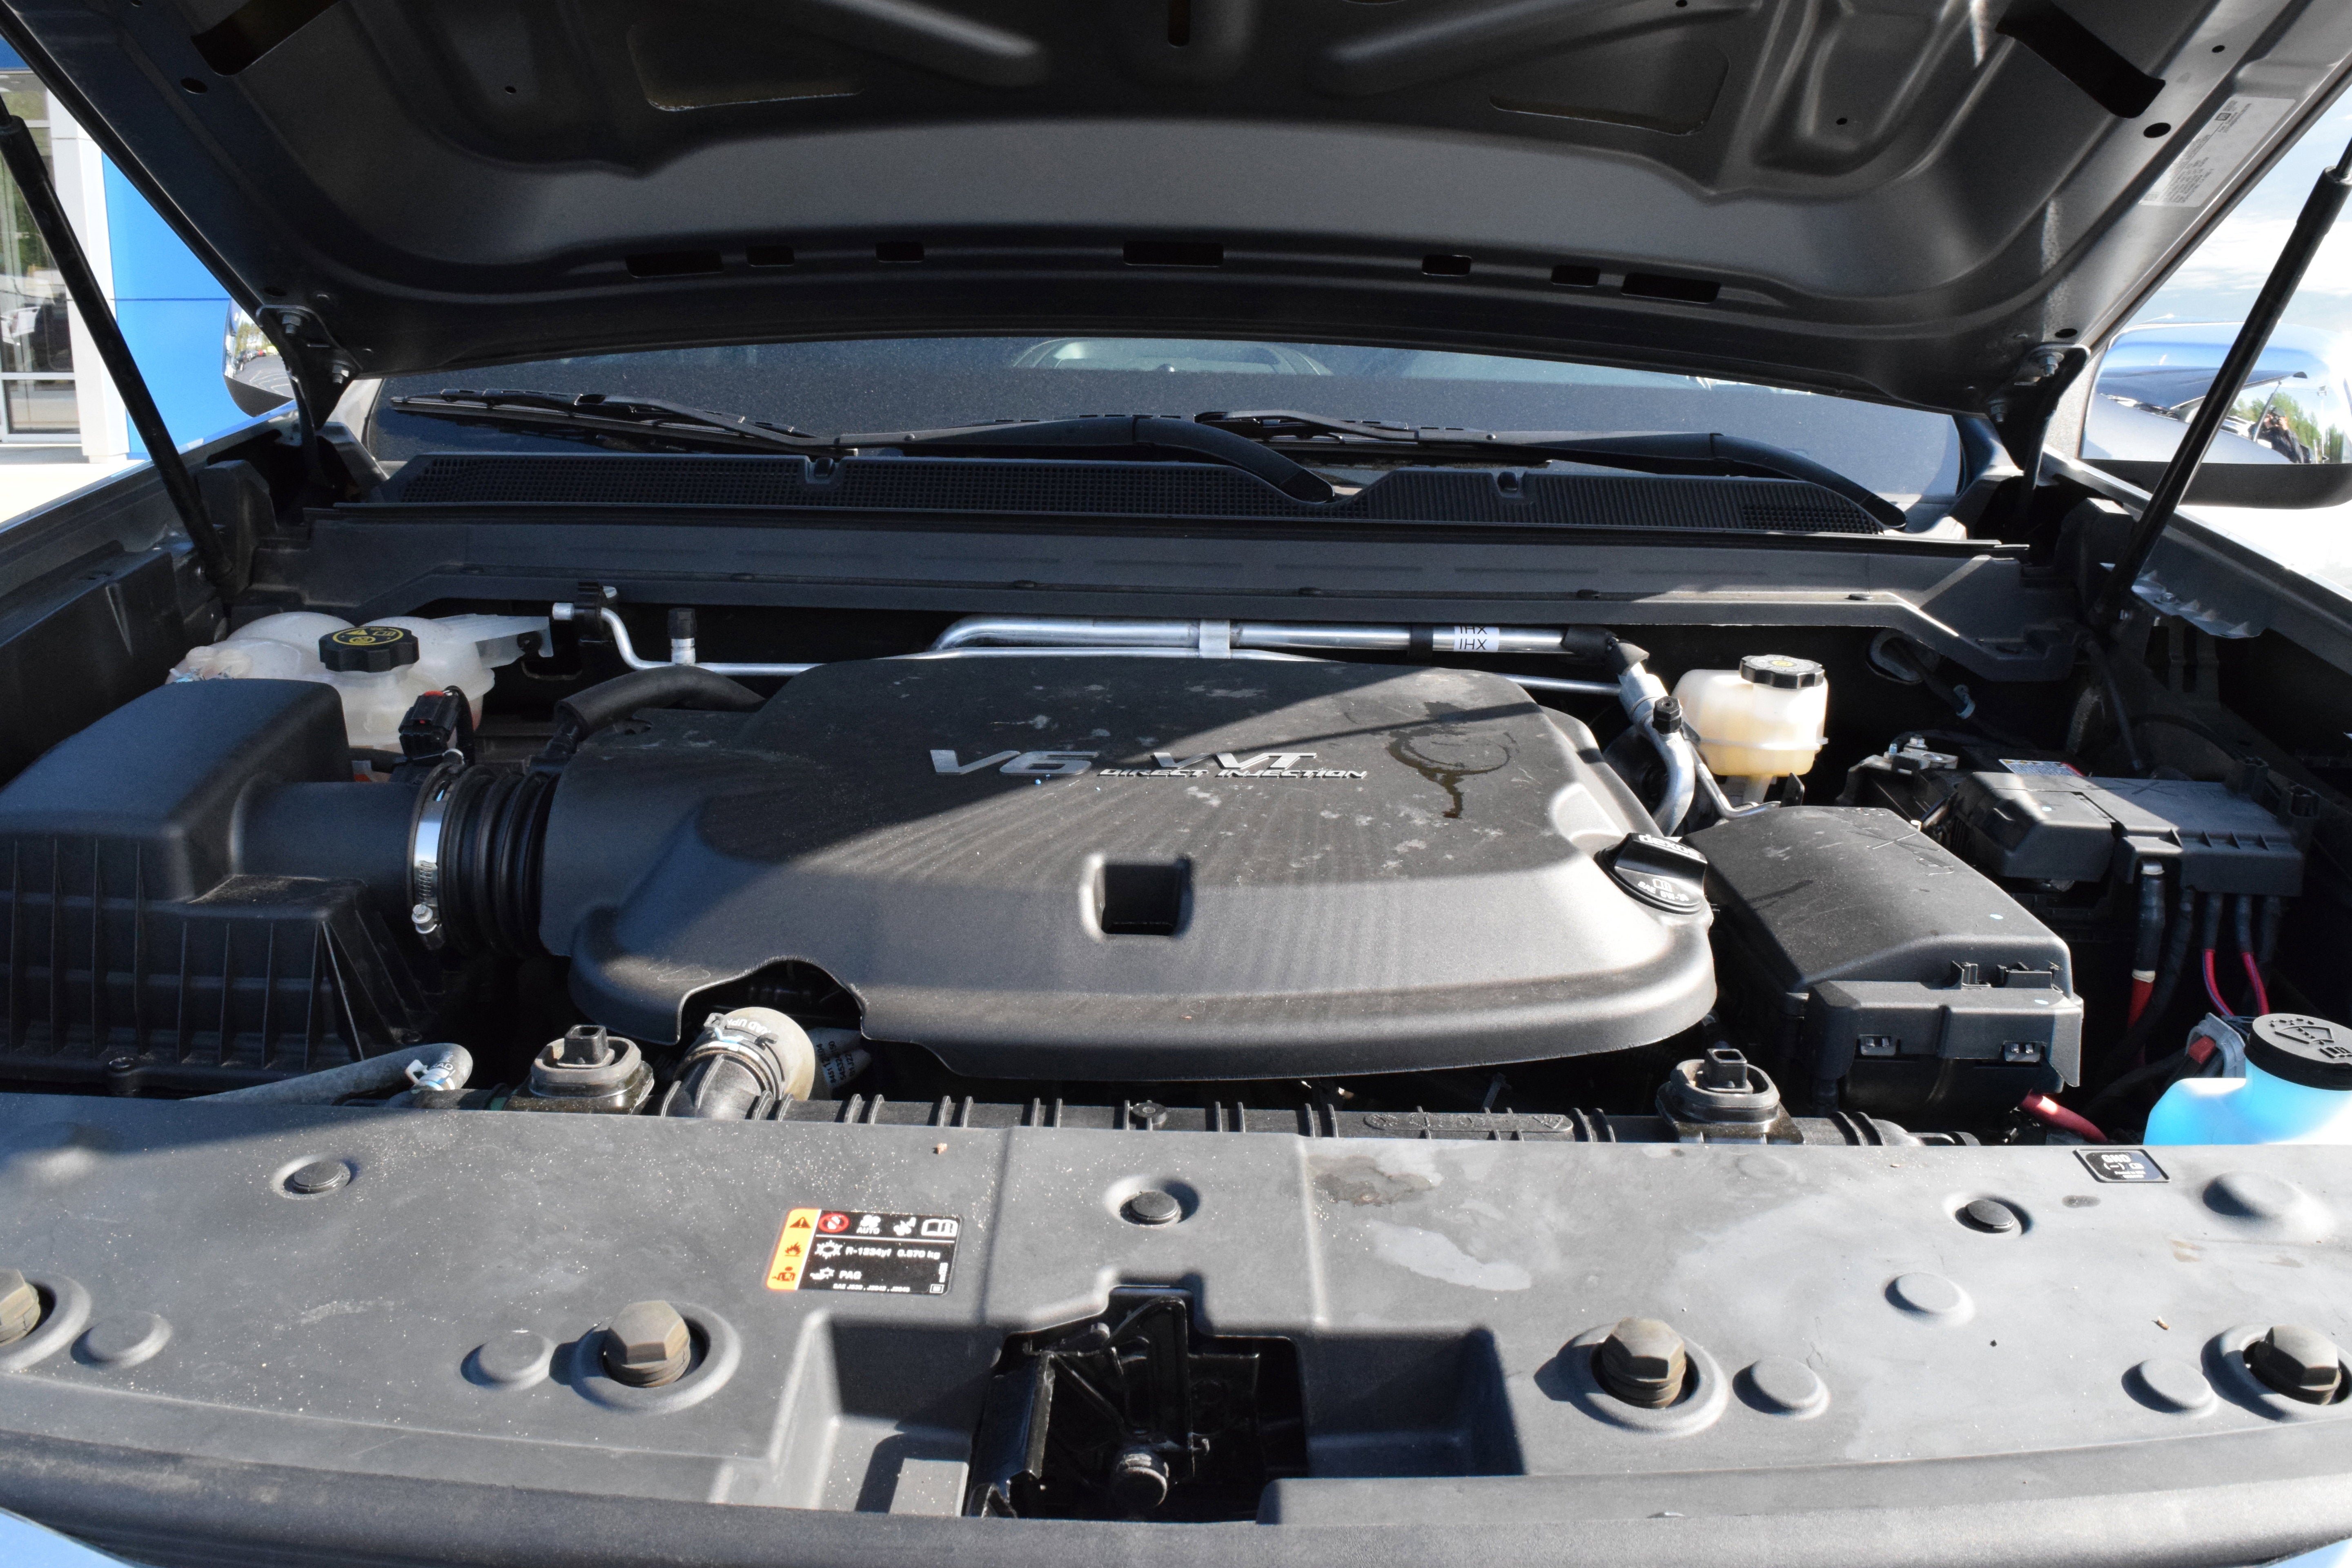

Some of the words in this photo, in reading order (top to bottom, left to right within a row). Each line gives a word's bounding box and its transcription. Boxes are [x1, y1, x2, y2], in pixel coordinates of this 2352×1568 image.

[1459, 638, 1487, 650] IHX
[930, 749, 1099, 775] V6
[1152, 752, 1317, 769] VVT
[1100, 768, 1209, 777] DIRECT
[1216, 769, 1368, 779] INJECTION
[1638, 834, 1701, 859] dexos
[1637, 881, 1657, 894] SAE
[2101, 1154, 2131, 1163] GND
[845, 1246, 892, 1257] R-1234yf
[927, 1250, 941, 1260] kg
[839, 1270, 862, 1280] PAG
